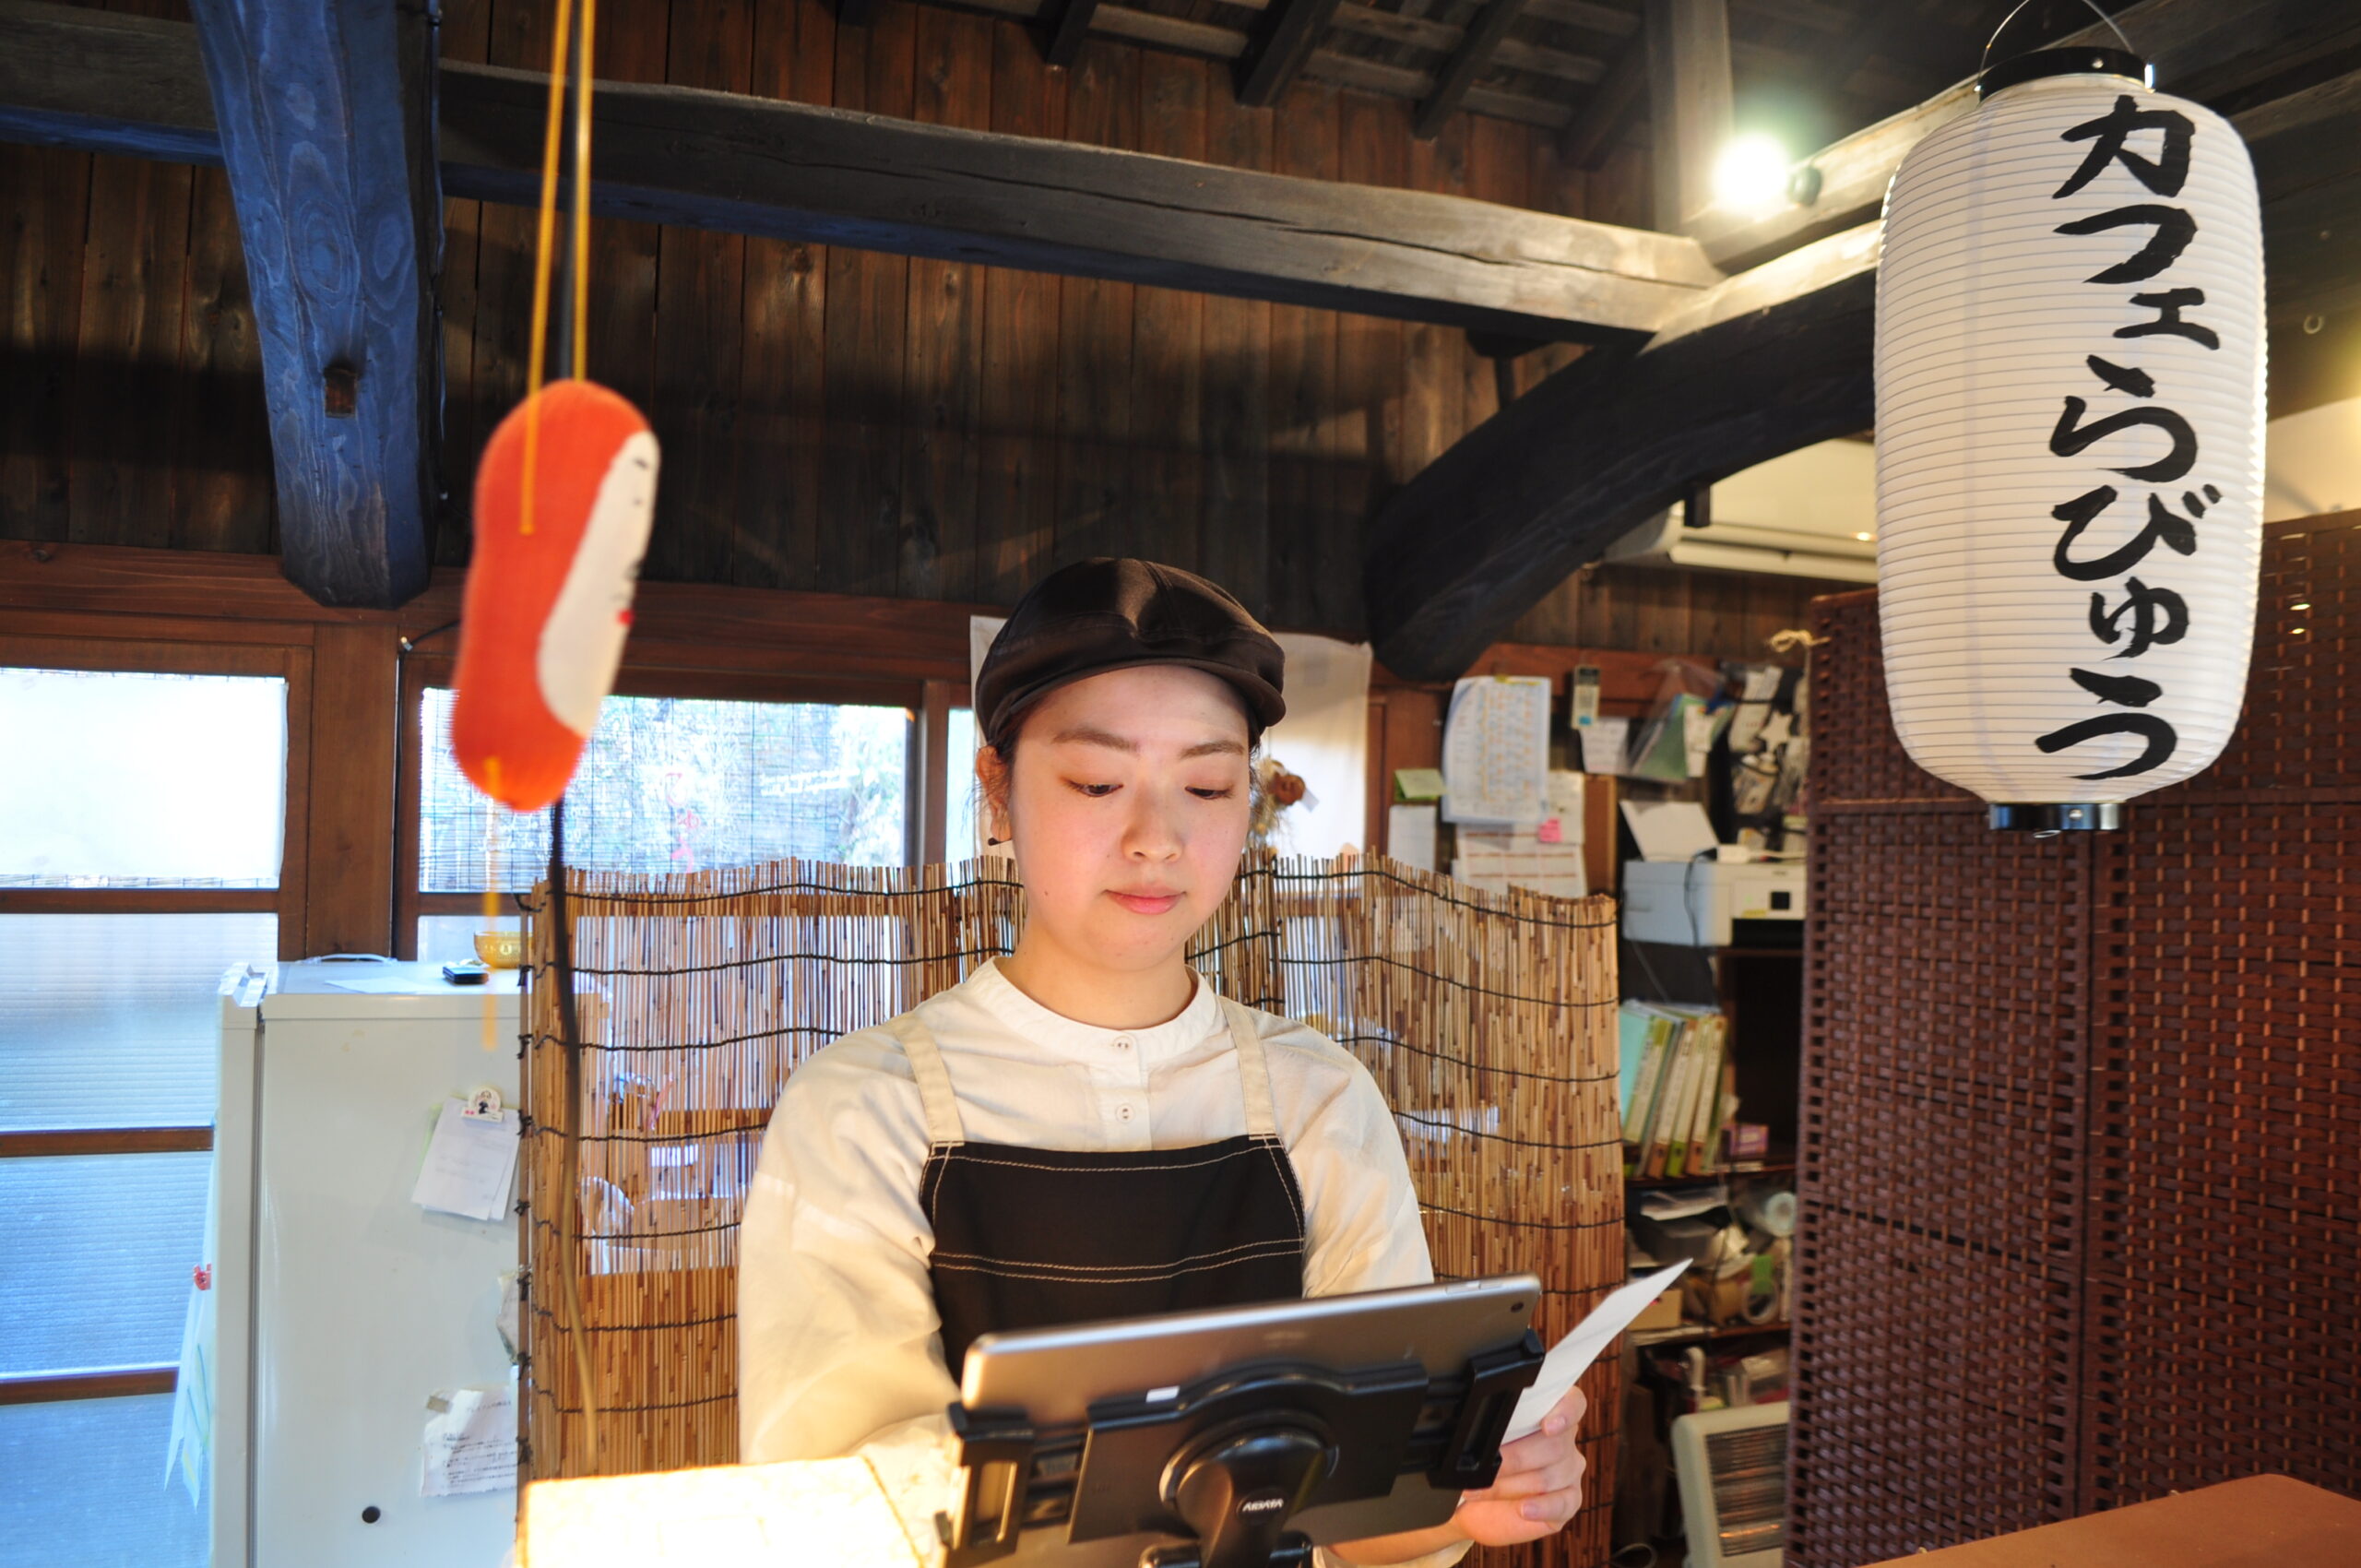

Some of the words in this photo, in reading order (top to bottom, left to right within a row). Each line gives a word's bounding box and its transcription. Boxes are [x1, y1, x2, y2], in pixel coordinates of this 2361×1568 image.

[2035, 94, 2222, 780] カフェらびゅう
